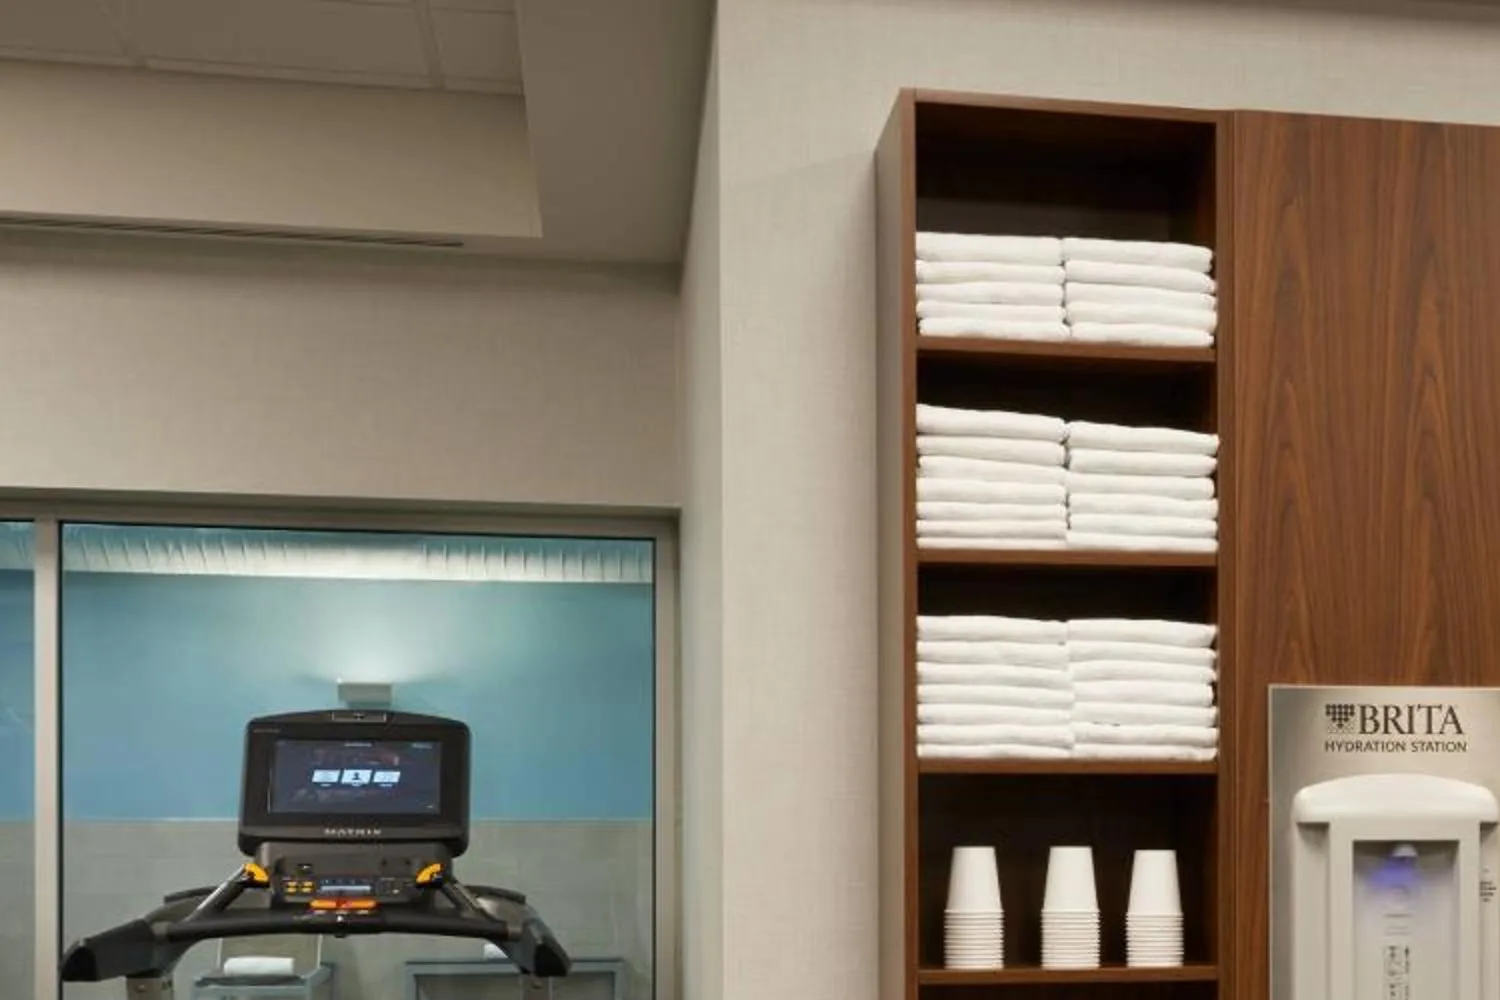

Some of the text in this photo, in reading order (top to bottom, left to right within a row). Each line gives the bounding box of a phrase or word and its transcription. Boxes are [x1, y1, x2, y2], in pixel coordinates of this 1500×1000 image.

[1358, 704, 1464, 734] BRITA
[1325, 741, 1467, 753] HYDRATION STATION
